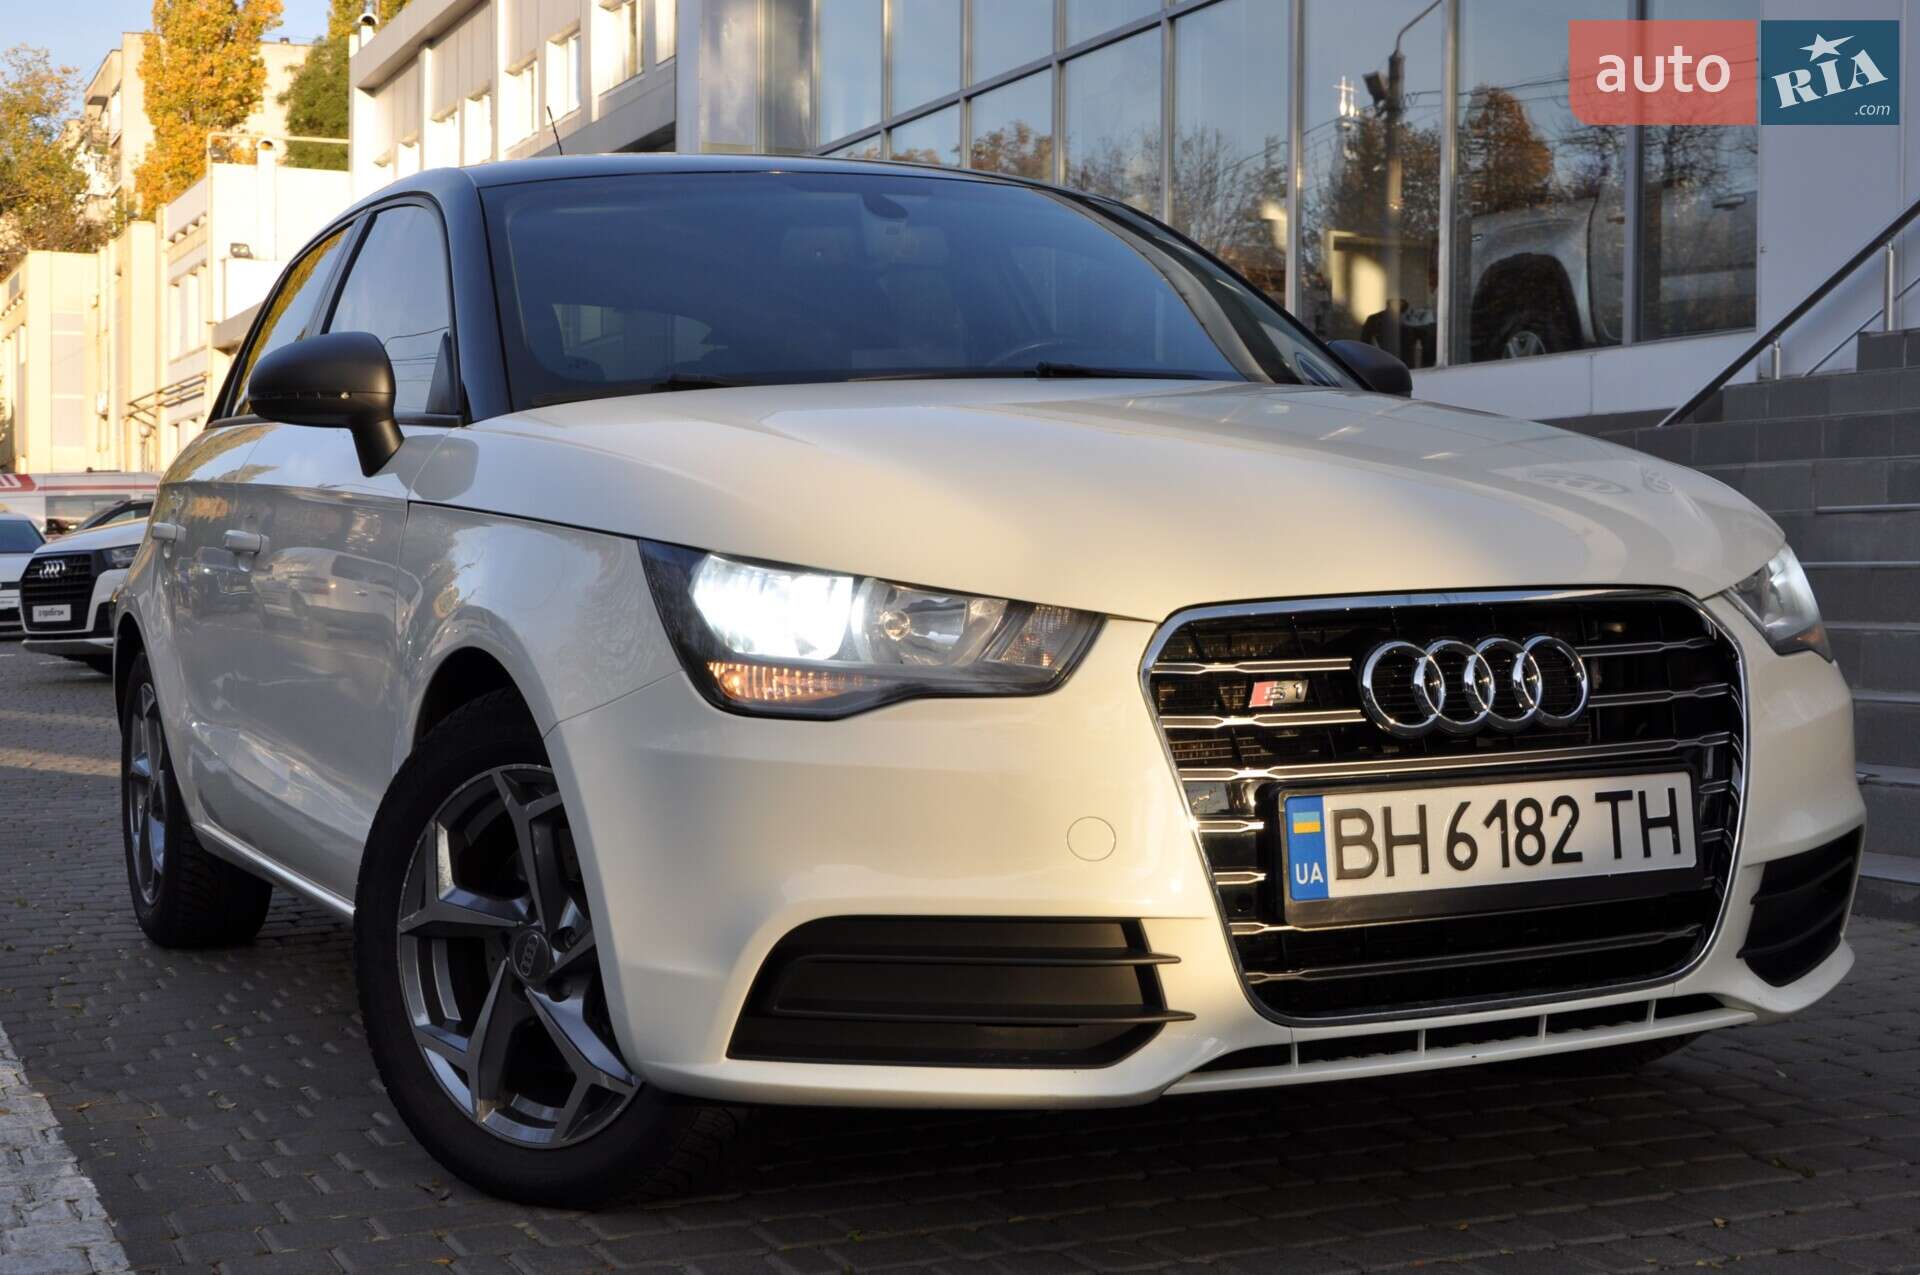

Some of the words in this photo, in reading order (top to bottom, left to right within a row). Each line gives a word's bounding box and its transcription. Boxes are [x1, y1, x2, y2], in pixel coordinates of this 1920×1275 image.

[1331, 804, 1430, 881] BH
[1446, 796, 1583, 872] 6182
[1595, 787, 1681, 860] TH
[1295, 862, 1324, 885] UA
